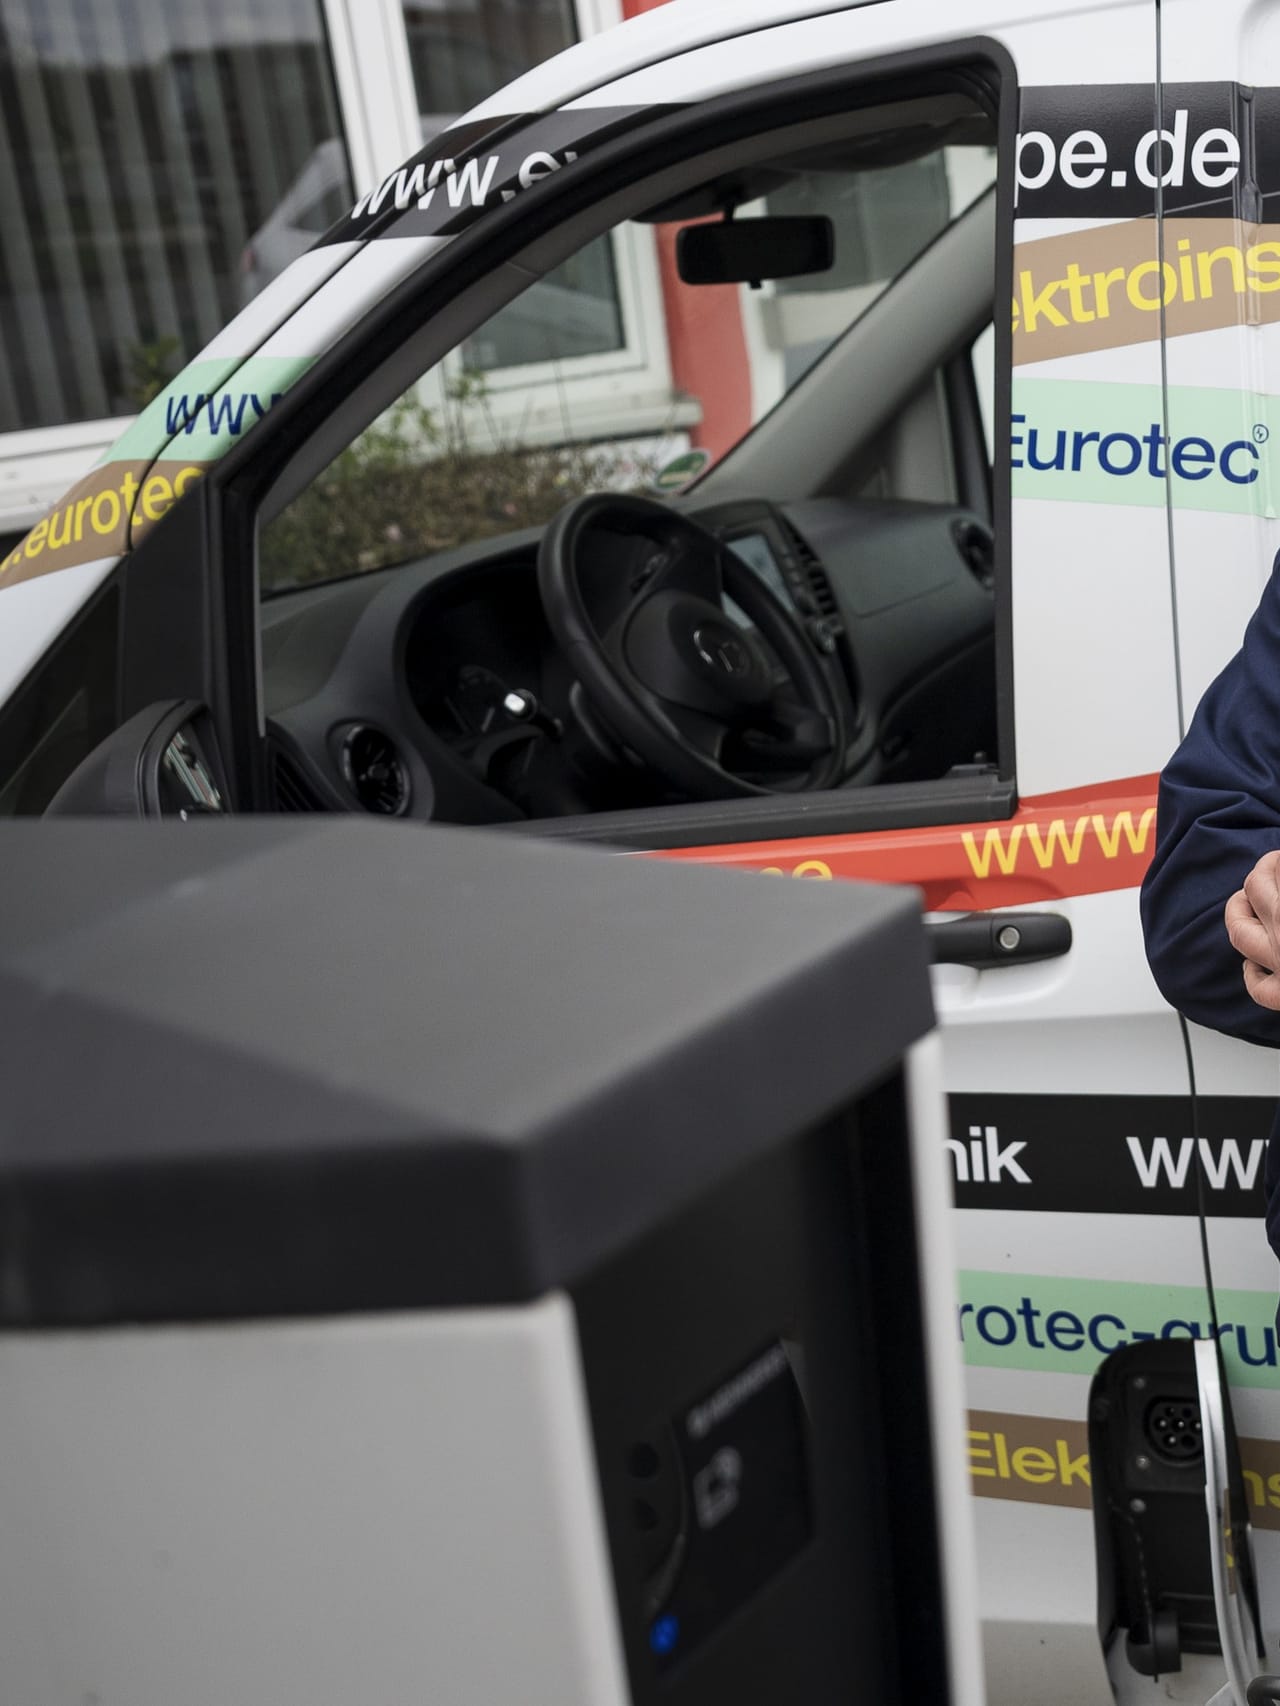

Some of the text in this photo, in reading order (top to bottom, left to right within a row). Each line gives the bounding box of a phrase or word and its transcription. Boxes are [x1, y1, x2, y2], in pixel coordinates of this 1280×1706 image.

[350, 151, 578, 219] www.e
[1013, 109, 1241, 209] pe.de
[960, 806, 1158, 879] www
[1125, 1136, 1271, 1190] ww
